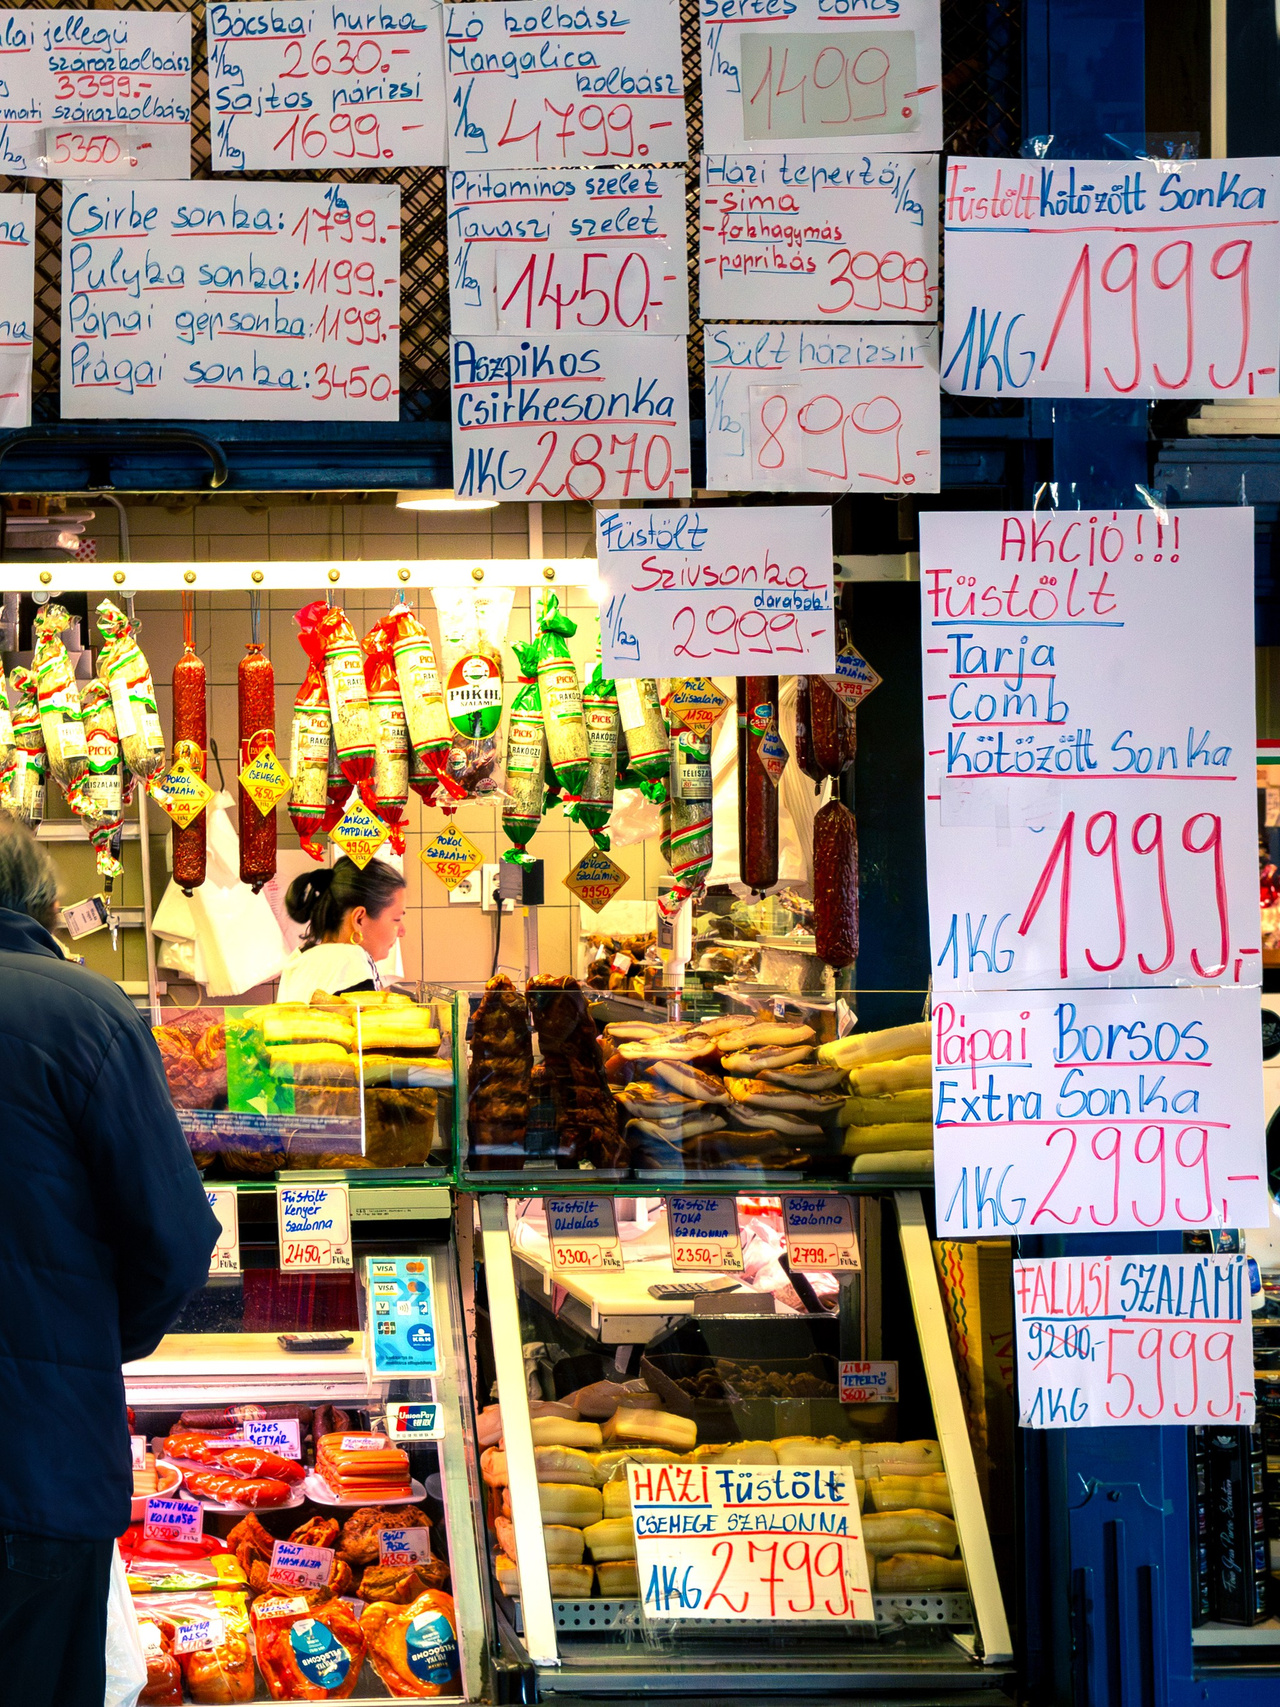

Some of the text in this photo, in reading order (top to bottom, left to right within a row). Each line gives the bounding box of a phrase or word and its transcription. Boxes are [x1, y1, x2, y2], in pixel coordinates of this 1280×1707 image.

[448, 41, 597, 78] Mangalica
[947, 165, 1040, 221] Füstölt
[1160, 172, 1266, 211] Sonka
[454, 342, 601, 390] Aszpikos
[601, 513, 708, 550] Füstölt
[926, 568, 1117, 619] Füstölt
[450, 687, 502, 702] POKOL
[590, 714, 612, 724] PICK
[88, 746, 112, 756] PICK
[1111, 727, 1231, 773] Sonka
[1054, 1003, 1208, 1063] Borsos
[936, 1068, 1199, 1125] Extra Sonka
[376, 1265, 394, 1274] VISA
[378, 1284, 395, 1293] VISA
[399, 1411, 436, 1422] UnionPay
[636, 1512, 848, 1535] CSEMEGE SZALONNA
